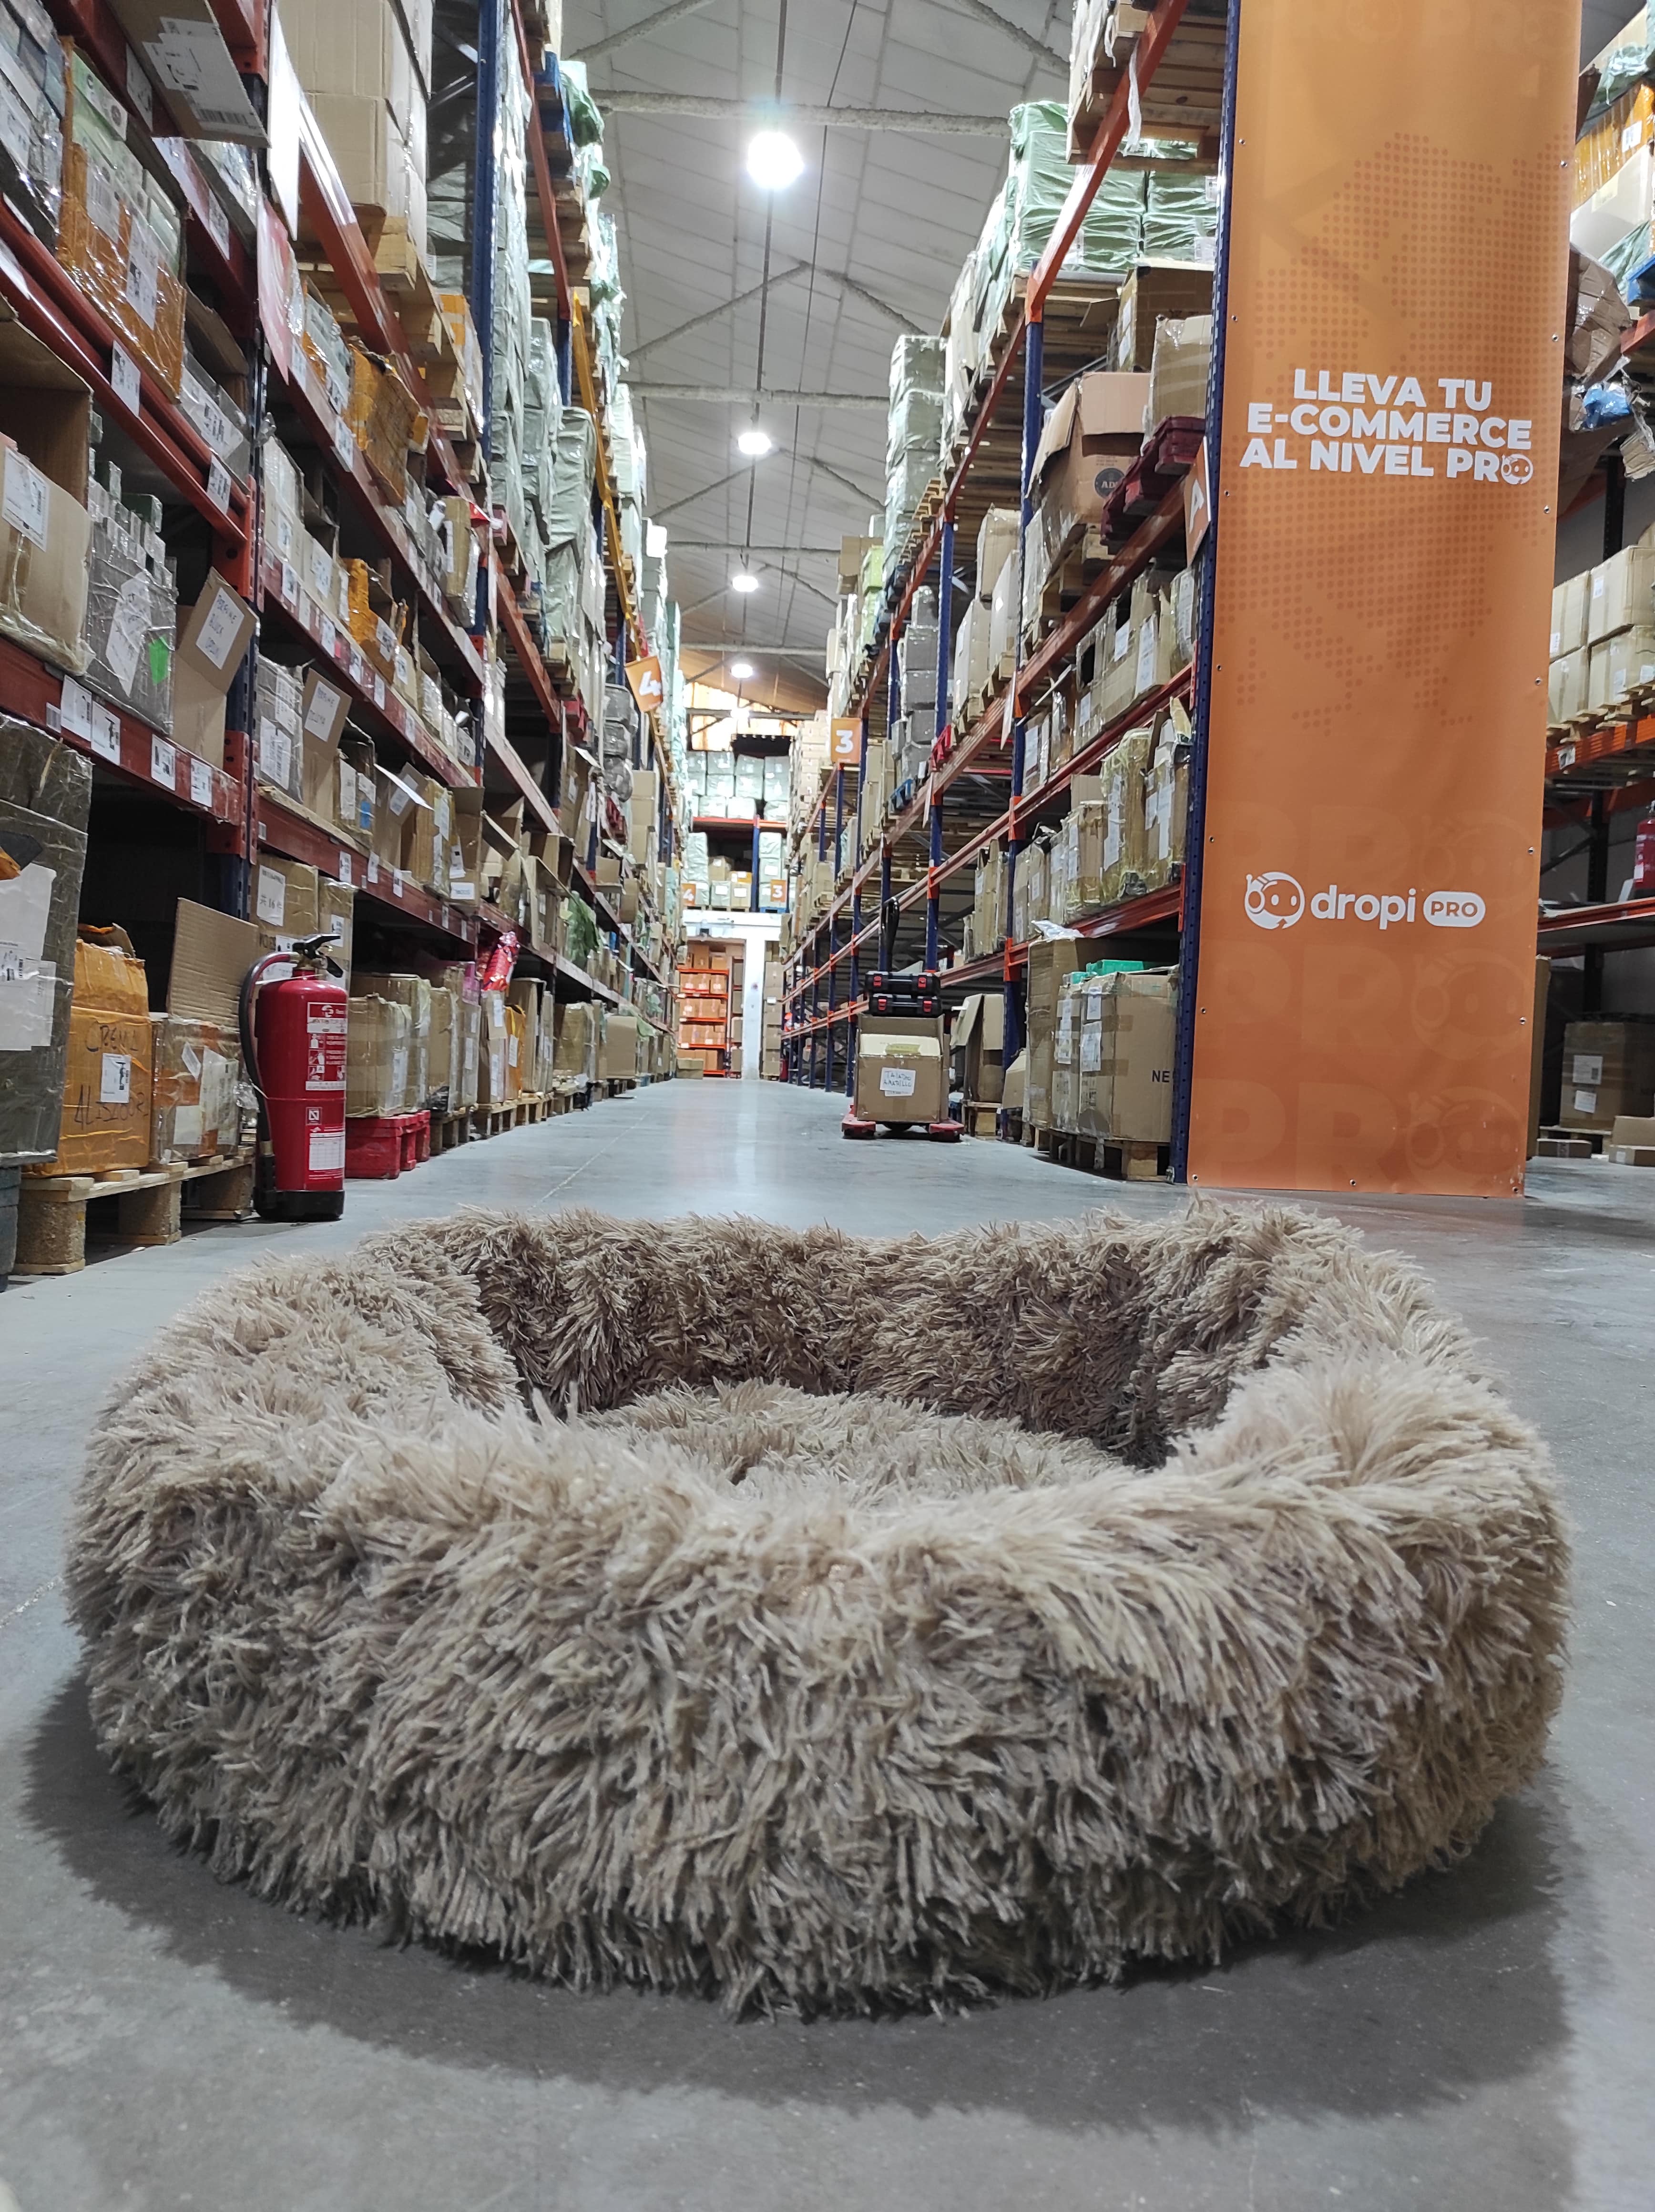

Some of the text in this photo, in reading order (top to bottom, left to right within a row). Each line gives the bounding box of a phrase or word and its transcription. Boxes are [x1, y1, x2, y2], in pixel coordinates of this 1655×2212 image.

[1294, 369, 1492, 411] LLEVA TU
[1247, 402, 1532, 450] E-COMMERCE
[1239, 438, 1297, 469] AL
[1310, 440, 1434, 477] NIVEL
[1189, 479, 1205, 534] A
[639, 670, 661, 696] 4
[835, 729, 853, 754] 3
[268, 898, 275, 909] 16
[683, 889, 694, 901] 4
[772, 885, 783, 899] 3
[1310, 884, 1478, 930] dropi PRO
